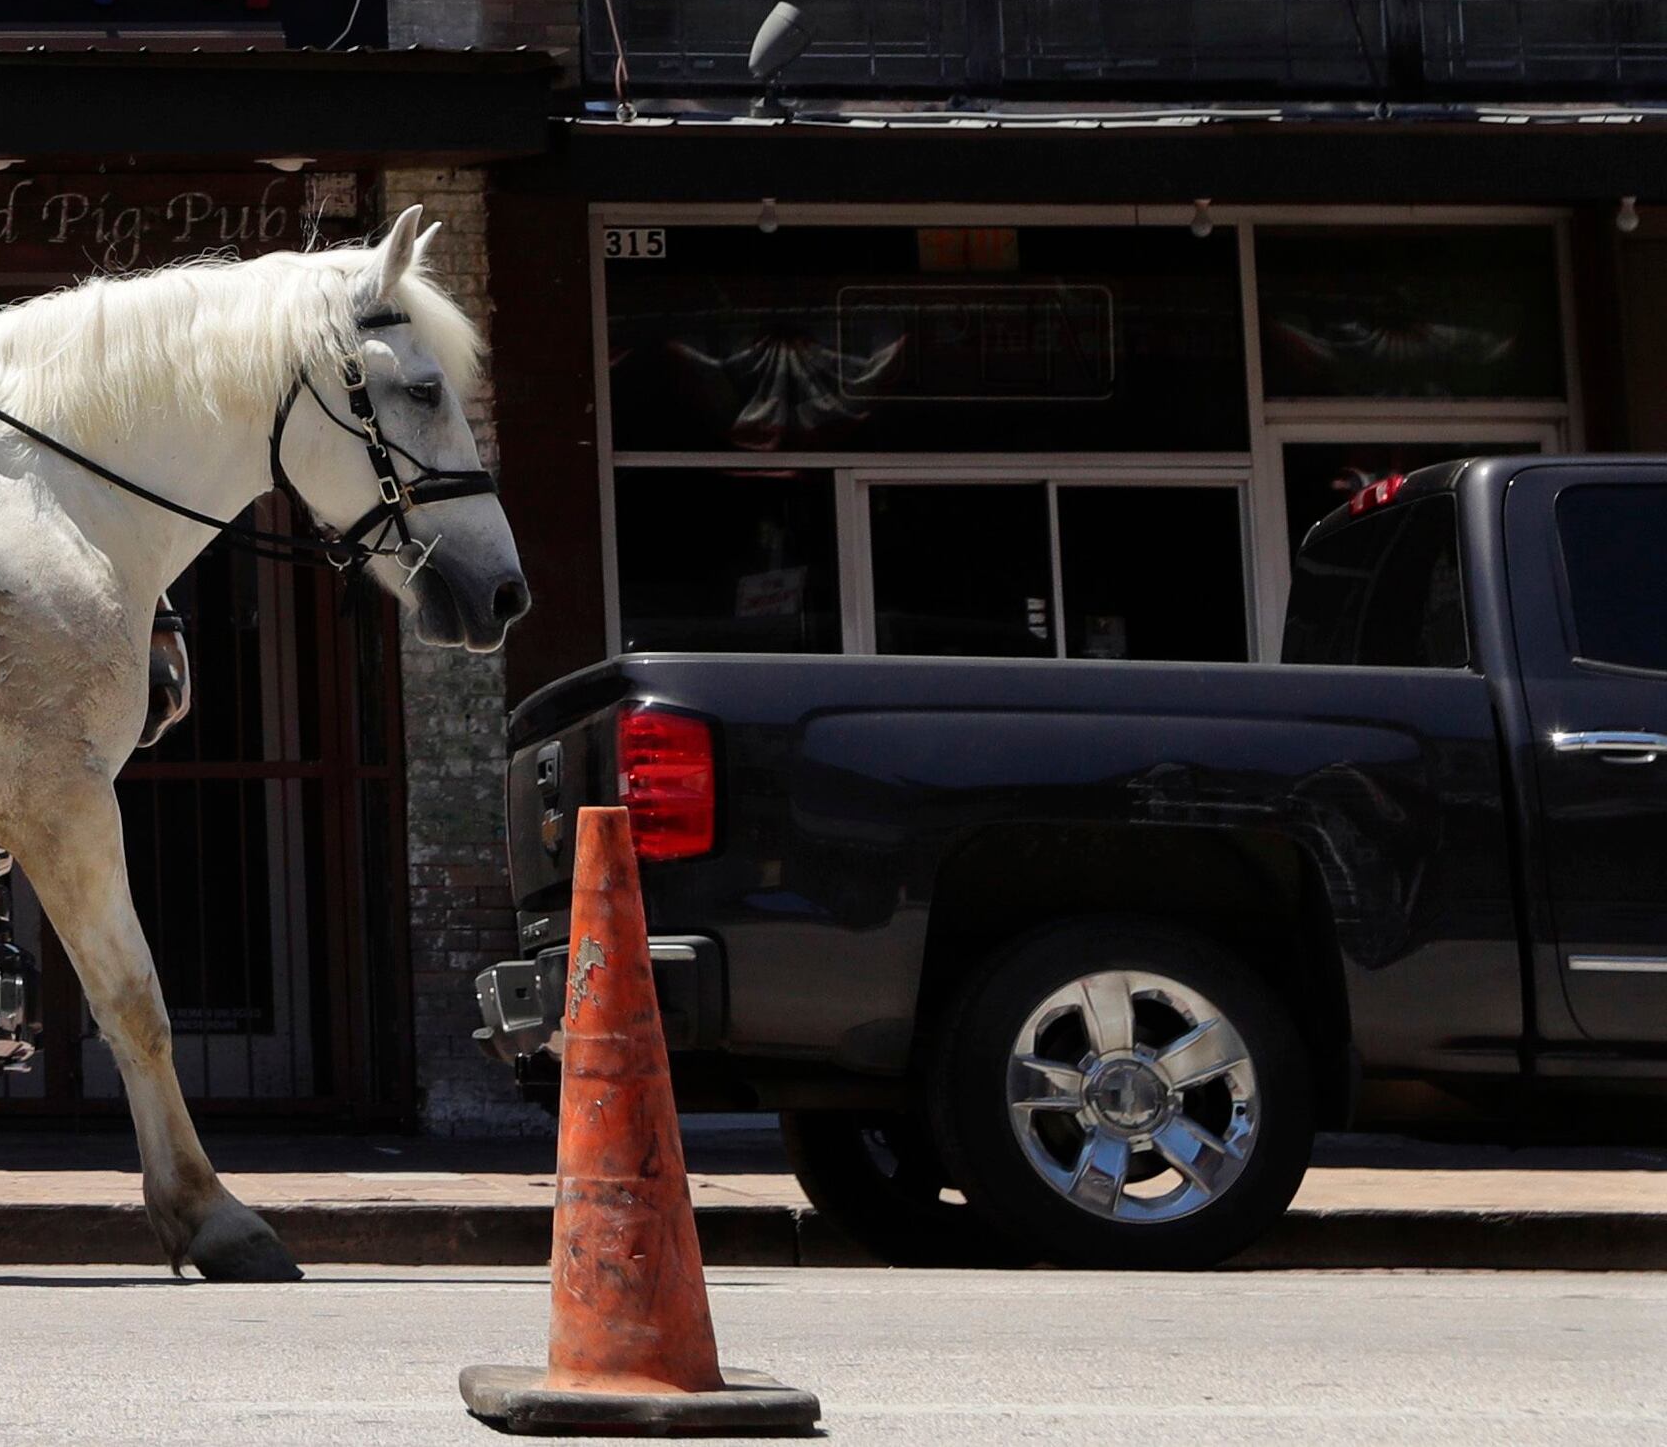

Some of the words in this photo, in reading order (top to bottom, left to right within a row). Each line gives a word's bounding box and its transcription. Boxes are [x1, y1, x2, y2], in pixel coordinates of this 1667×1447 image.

[41, 187, 146, 266] Pig
[166, 178, 287, 244] Pub
[604, 229, 666, 258] 315
